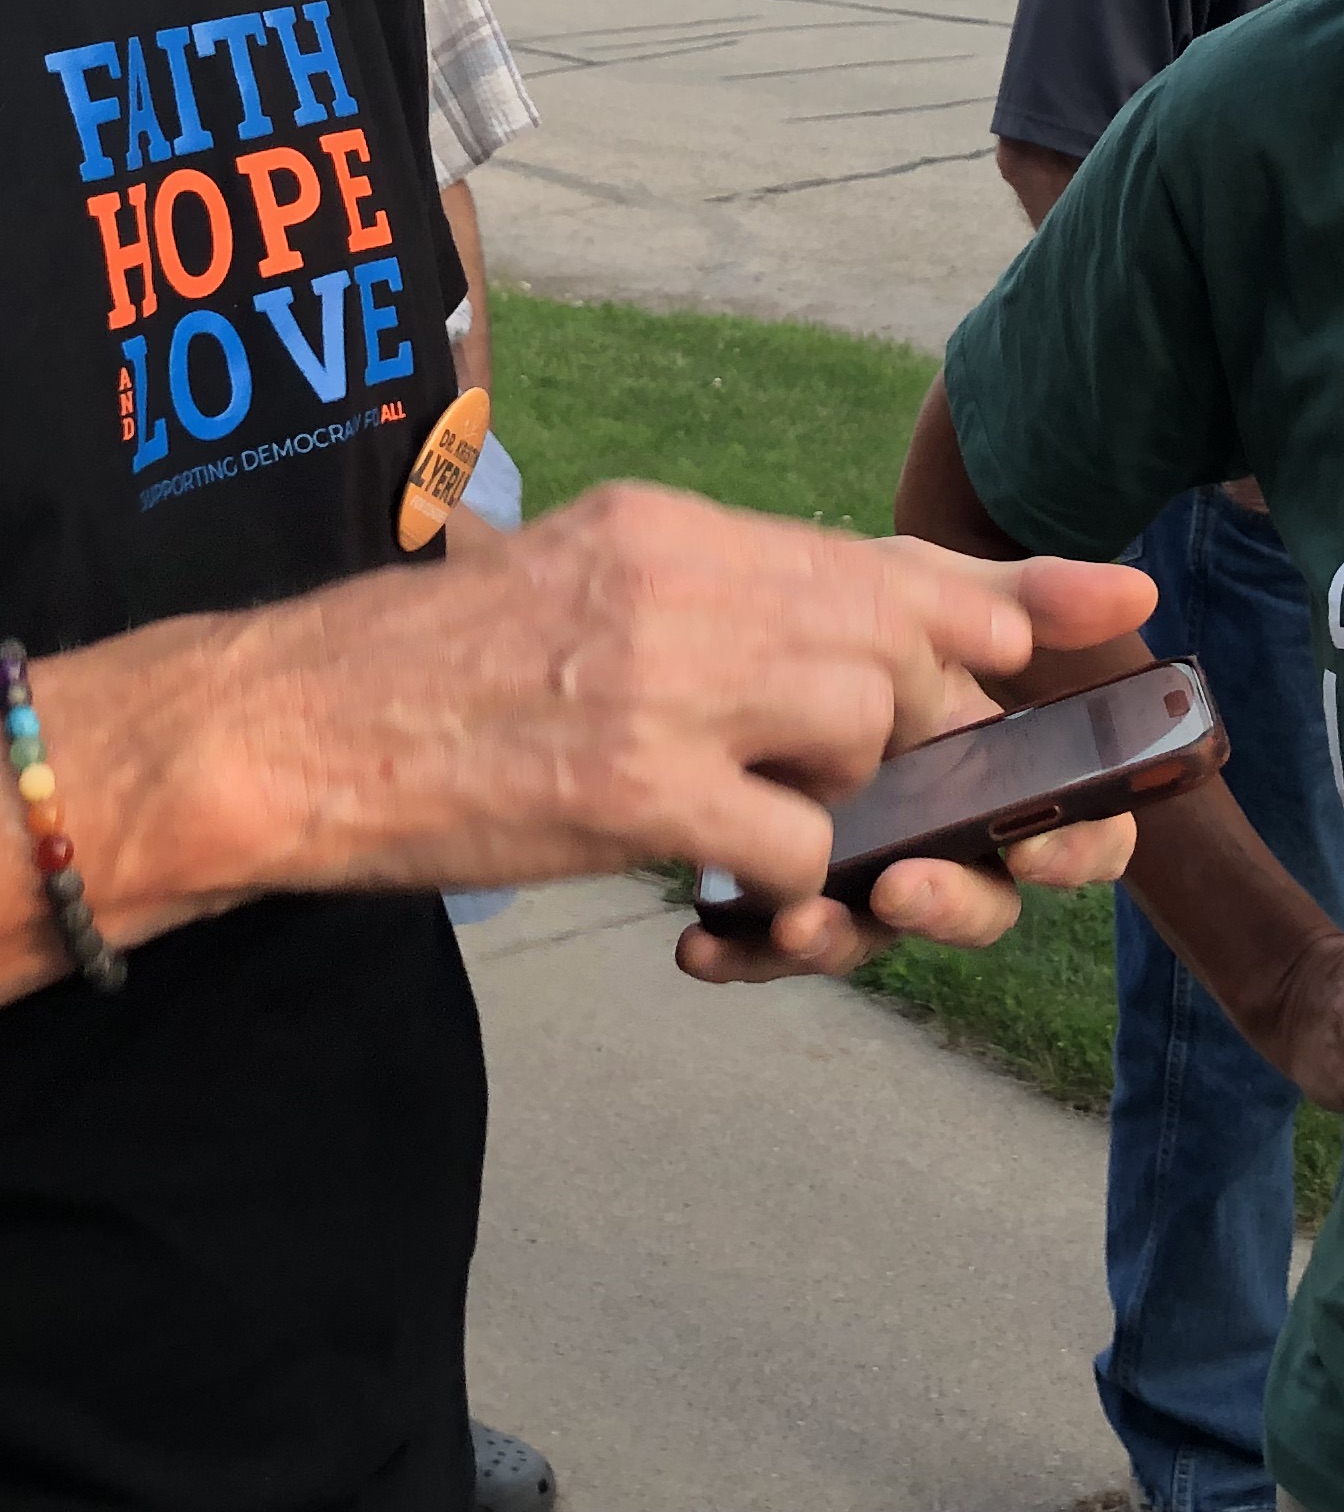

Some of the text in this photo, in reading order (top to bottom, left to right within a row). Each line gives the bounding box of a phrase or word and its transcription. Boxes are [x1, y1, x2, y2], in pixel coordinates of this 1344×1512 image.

[44, 0, 358, 182] FAITH
[87, 128, 393, 330] HOPE
[118, 366, 135, 441] AND
[121, 256, 414, 474] LOVE
[380, 400, 407, 424] ALL
